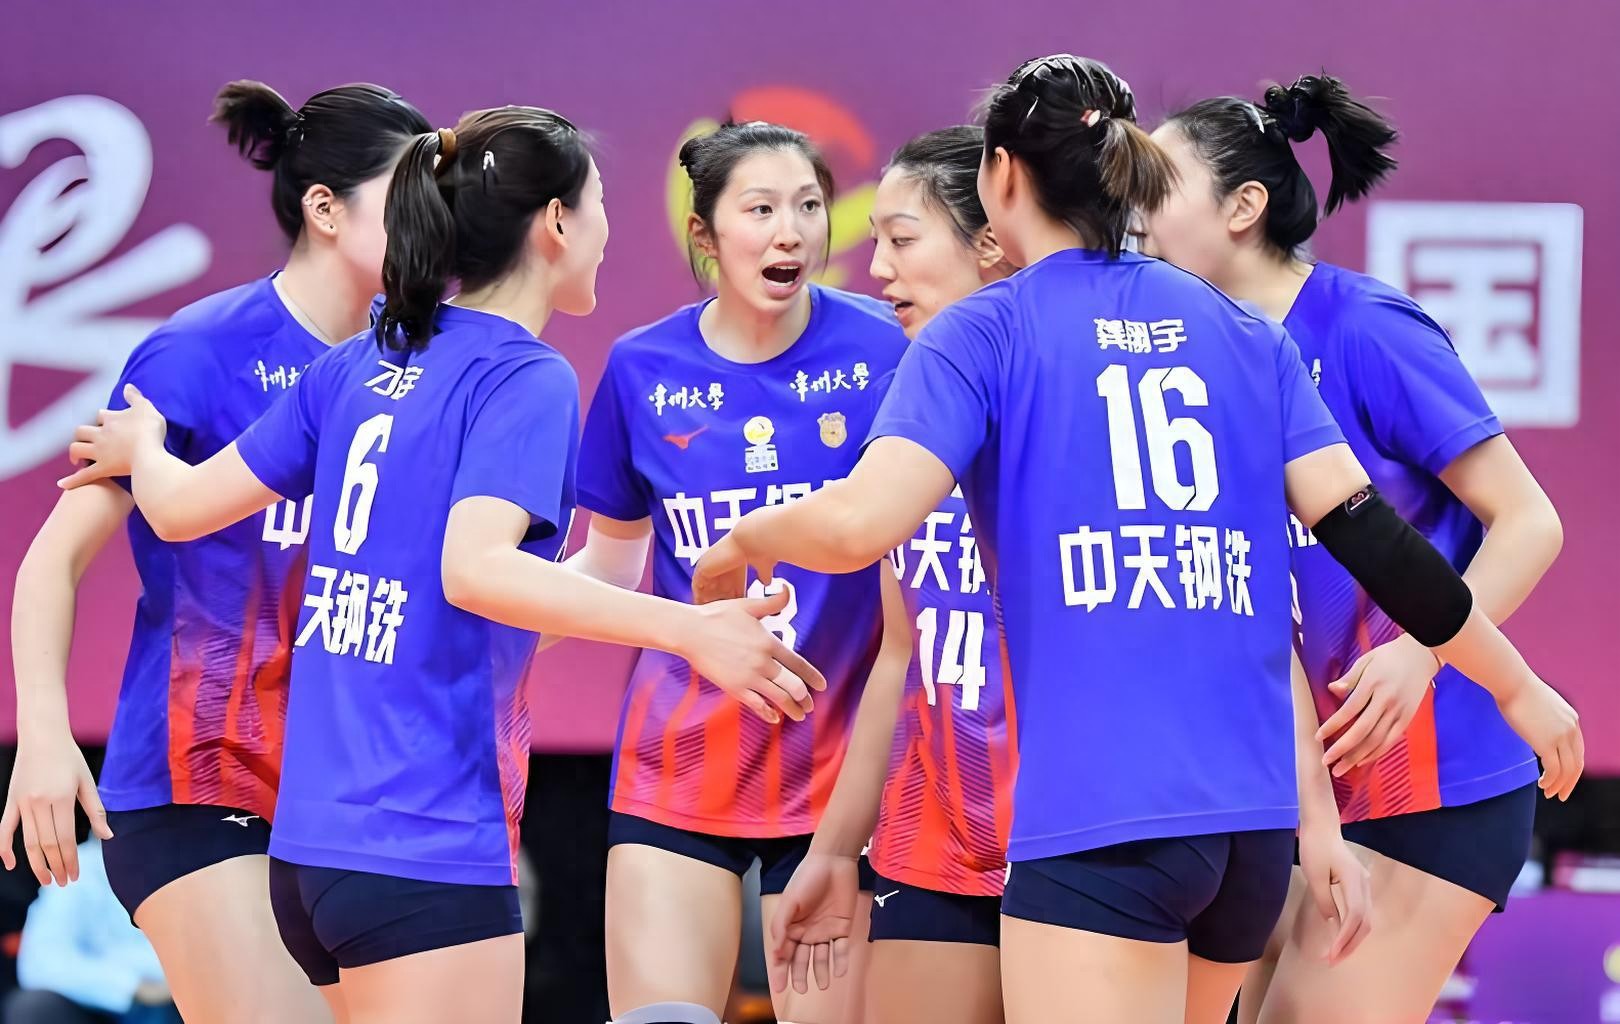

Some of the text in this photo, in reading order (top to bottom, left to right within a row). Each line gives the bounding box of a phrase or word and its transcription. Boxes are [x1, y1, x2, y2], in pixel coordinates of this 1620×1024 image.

[1366, 202, 1584, 427] 国
[333, 413, 394, 555] 6
[1096, 364, 1220, 511] 16
[662, 479, 852, 567] 中天
[1058, 525, 1254, 617] 中天钢铁
[294, 564, 408, 665] 天钢铁
[916, 607, 985, 711] 14
